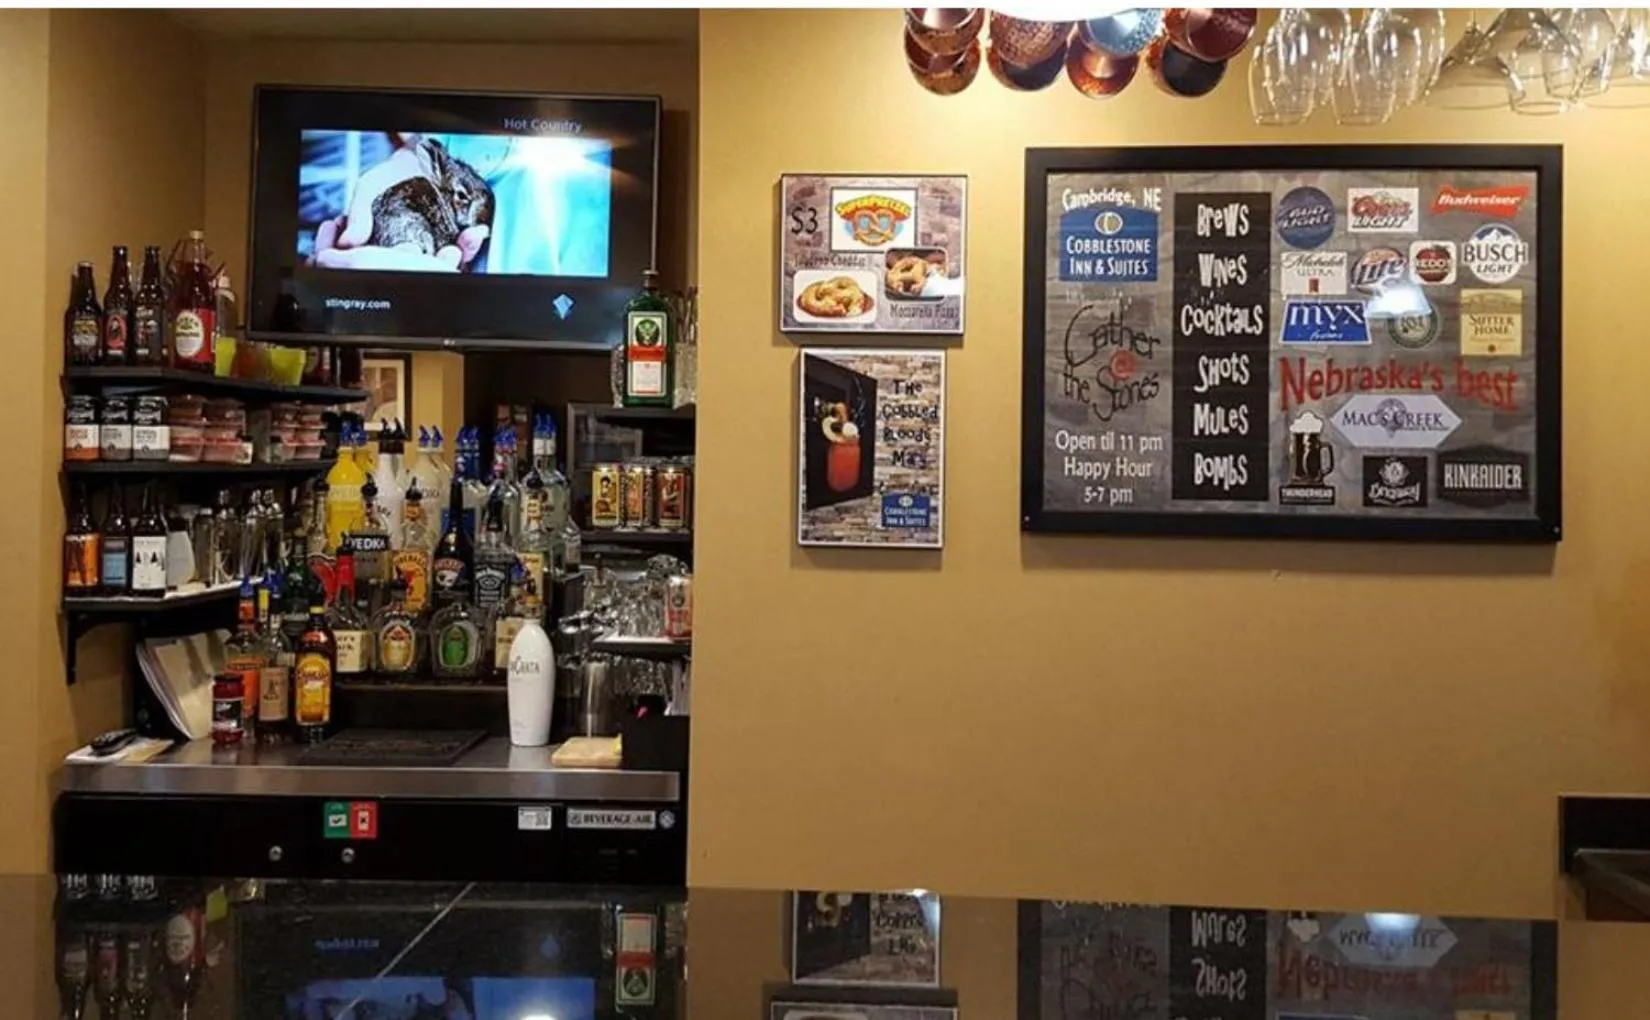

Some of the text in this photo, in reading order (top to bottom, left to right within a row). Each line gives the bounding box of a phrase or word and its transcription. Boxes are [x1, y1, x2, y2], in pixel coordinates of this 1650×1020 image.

[503, 117, 582, 134] Hot Country
[1143, 187, 1163, 212] NE
[1066, 235, 1151, 254] COBBLESTONE
[1464, 243, 1526, 262] BUSCH
[1094, 258, 1105, 275] &
[1476, 263, 1513, 274] LIGHT
[325, 298, 391, 310] stingray.com
[1468, 312, 1515, 327] SUTTER
[1473, 325, 1510, 336] HOME
[1278, 356, 1520, 412] Nebraska's best
[1055, 429, 1097, 454] Open
[1120, 434, 1134, 451] 11
[1140, 435, 1164, 455] pm
[1064, 456, 1155, 480] Happy Hour
[1443, 463, 1523, 490] KINKAIDER
[1083, 486, 1133, 507] 5-7 pm
